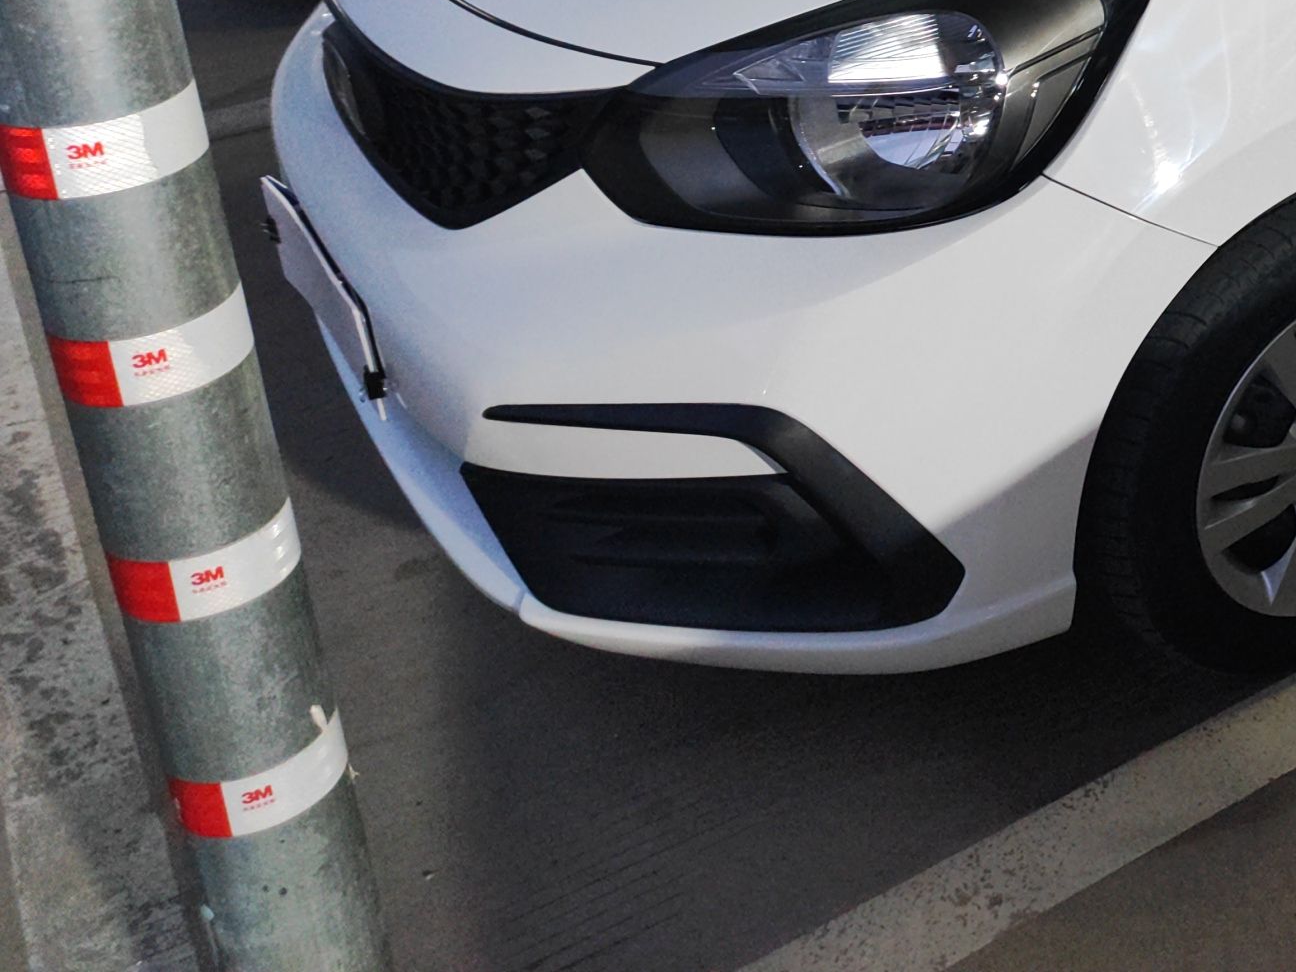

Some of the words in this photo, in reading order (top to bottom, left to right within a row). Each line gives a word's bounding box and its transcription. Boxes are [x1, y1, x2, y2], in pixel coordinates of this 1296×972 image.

[66, 141, 104, 159] 3M
[132, 348, 168, 368] 3M
[190, 566, 225, 585] 3M
[241, 784, 273, 804] 3M
